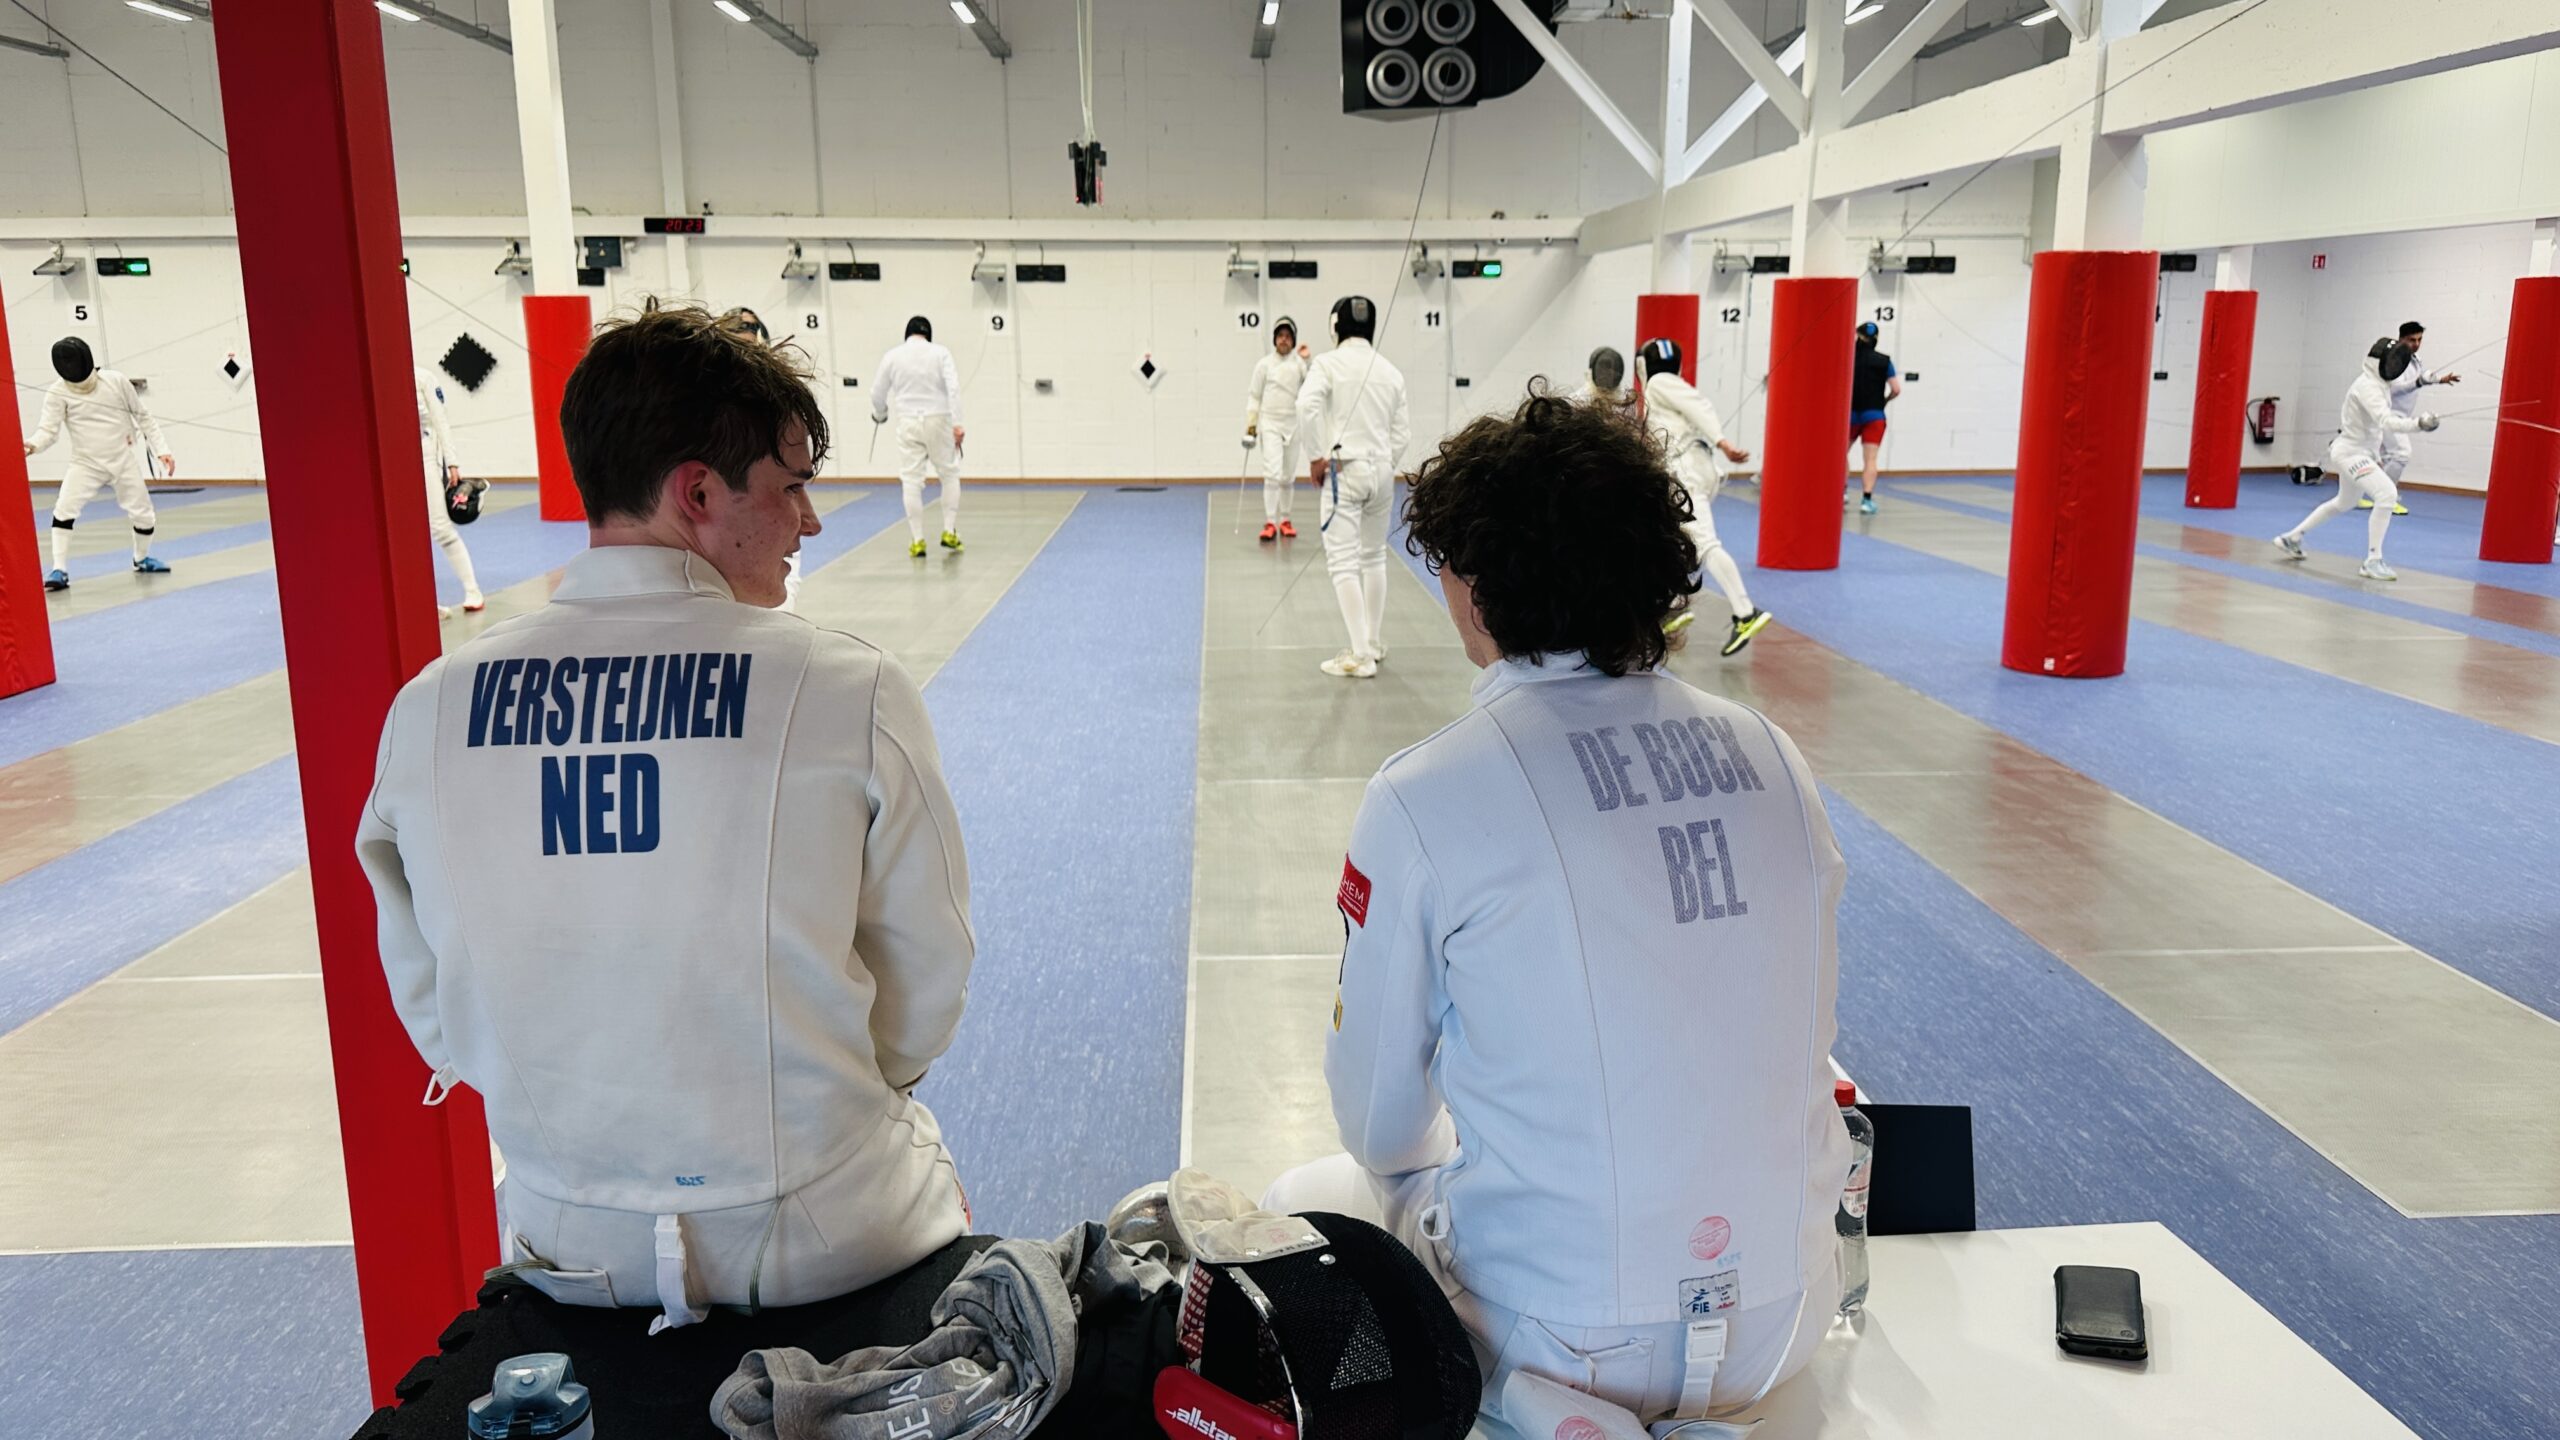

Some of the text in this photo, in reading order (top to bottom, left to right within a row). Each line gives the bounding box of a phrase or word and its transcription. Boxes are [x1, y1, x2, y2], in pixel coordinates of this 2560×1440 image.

[75, 305, 88, 321] 5
[1239, 312, 1260, 328] 10
[1425, 311, 1440, 327] 11
[1721, 308, 1741, 323] 12
[1874, 306, 1895, 322] 13
[806, 314, 819, 329] 8
[991, 315, 1004, 331] 9
[467, 652, 752, 748] VERSTEIJNEN
[1565, 716, 1766, 812] DE BOCK
[541, 752, 660, 856] NED
[1656, 818, 1748, 924] BEL
[1691, 1301, 1711, 1314] FIE
